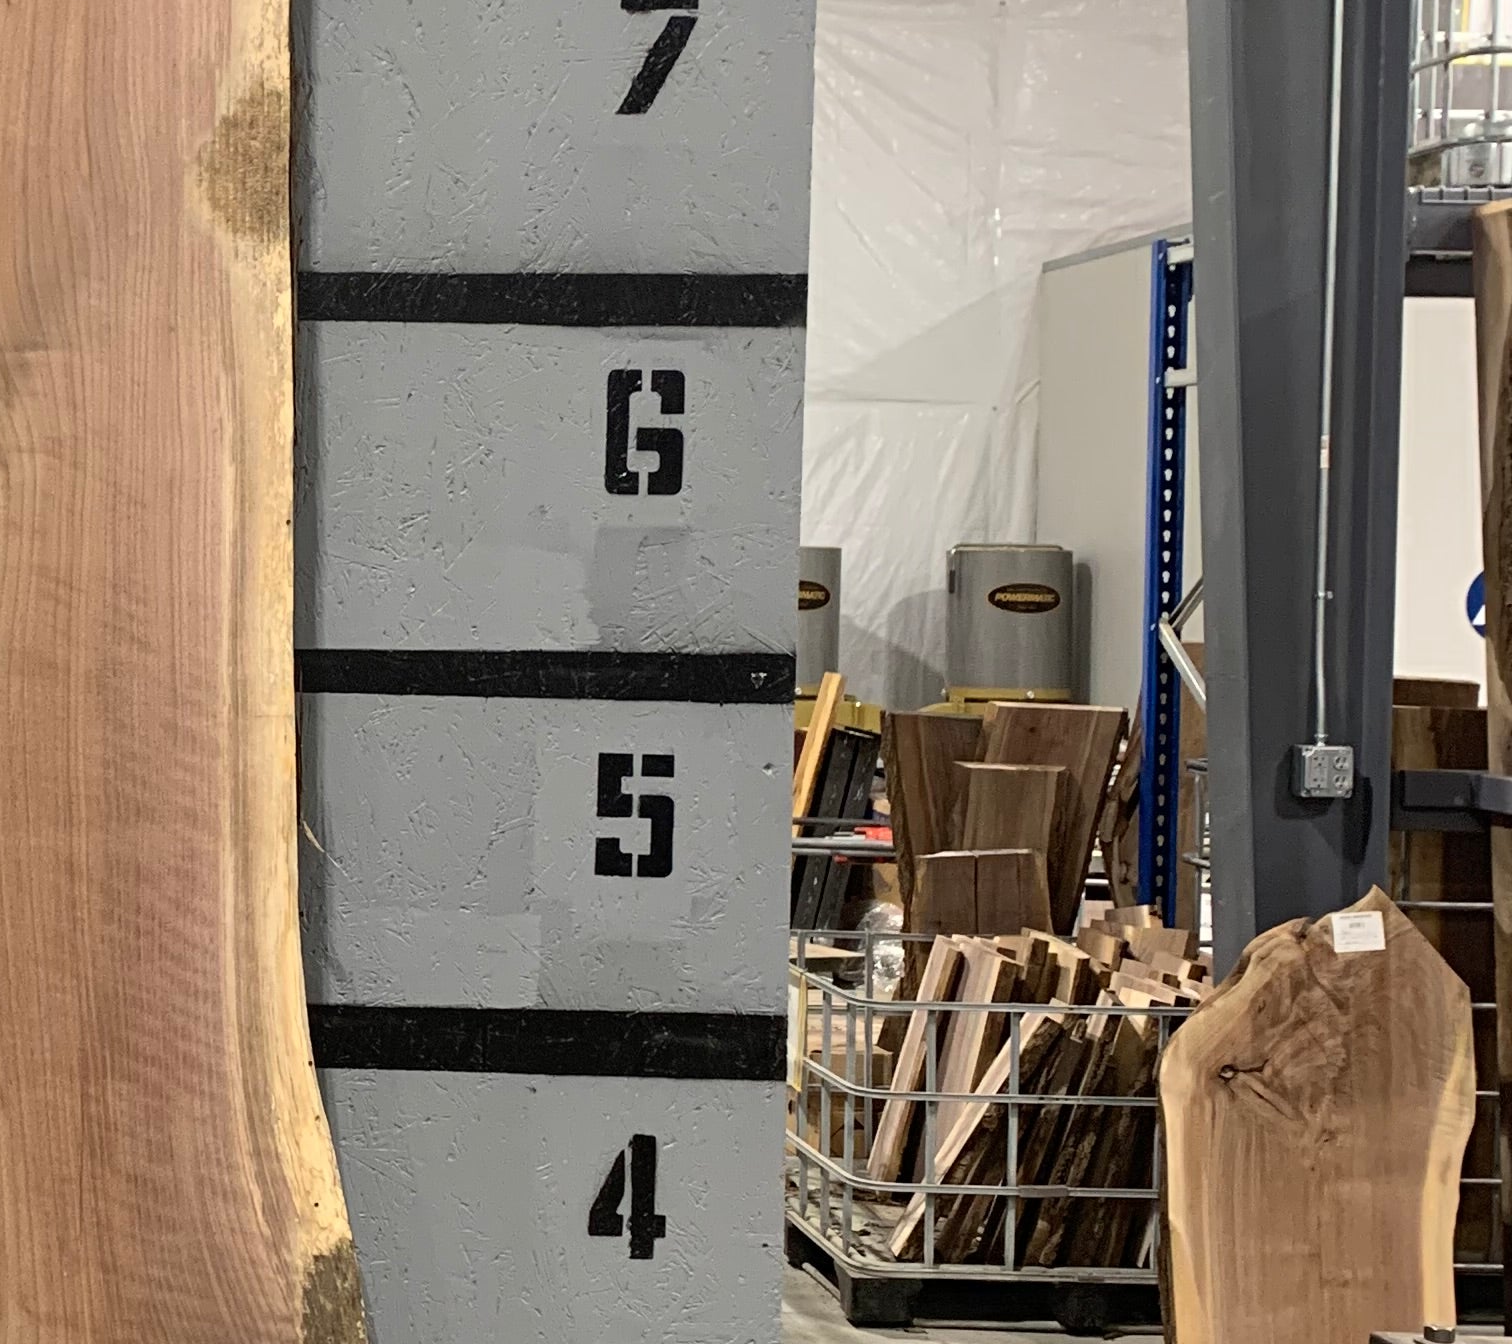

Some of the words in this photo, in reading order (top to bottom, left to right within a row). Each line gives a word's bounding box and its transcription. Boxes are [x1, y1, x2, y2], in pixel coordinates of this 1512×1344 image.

[605, 369, 685, 495] 6
[994, 592, 1056, 603] POWERMATIC
[595, 753, 674, 877] 5
[588, 1134, 666, 1259] 4
